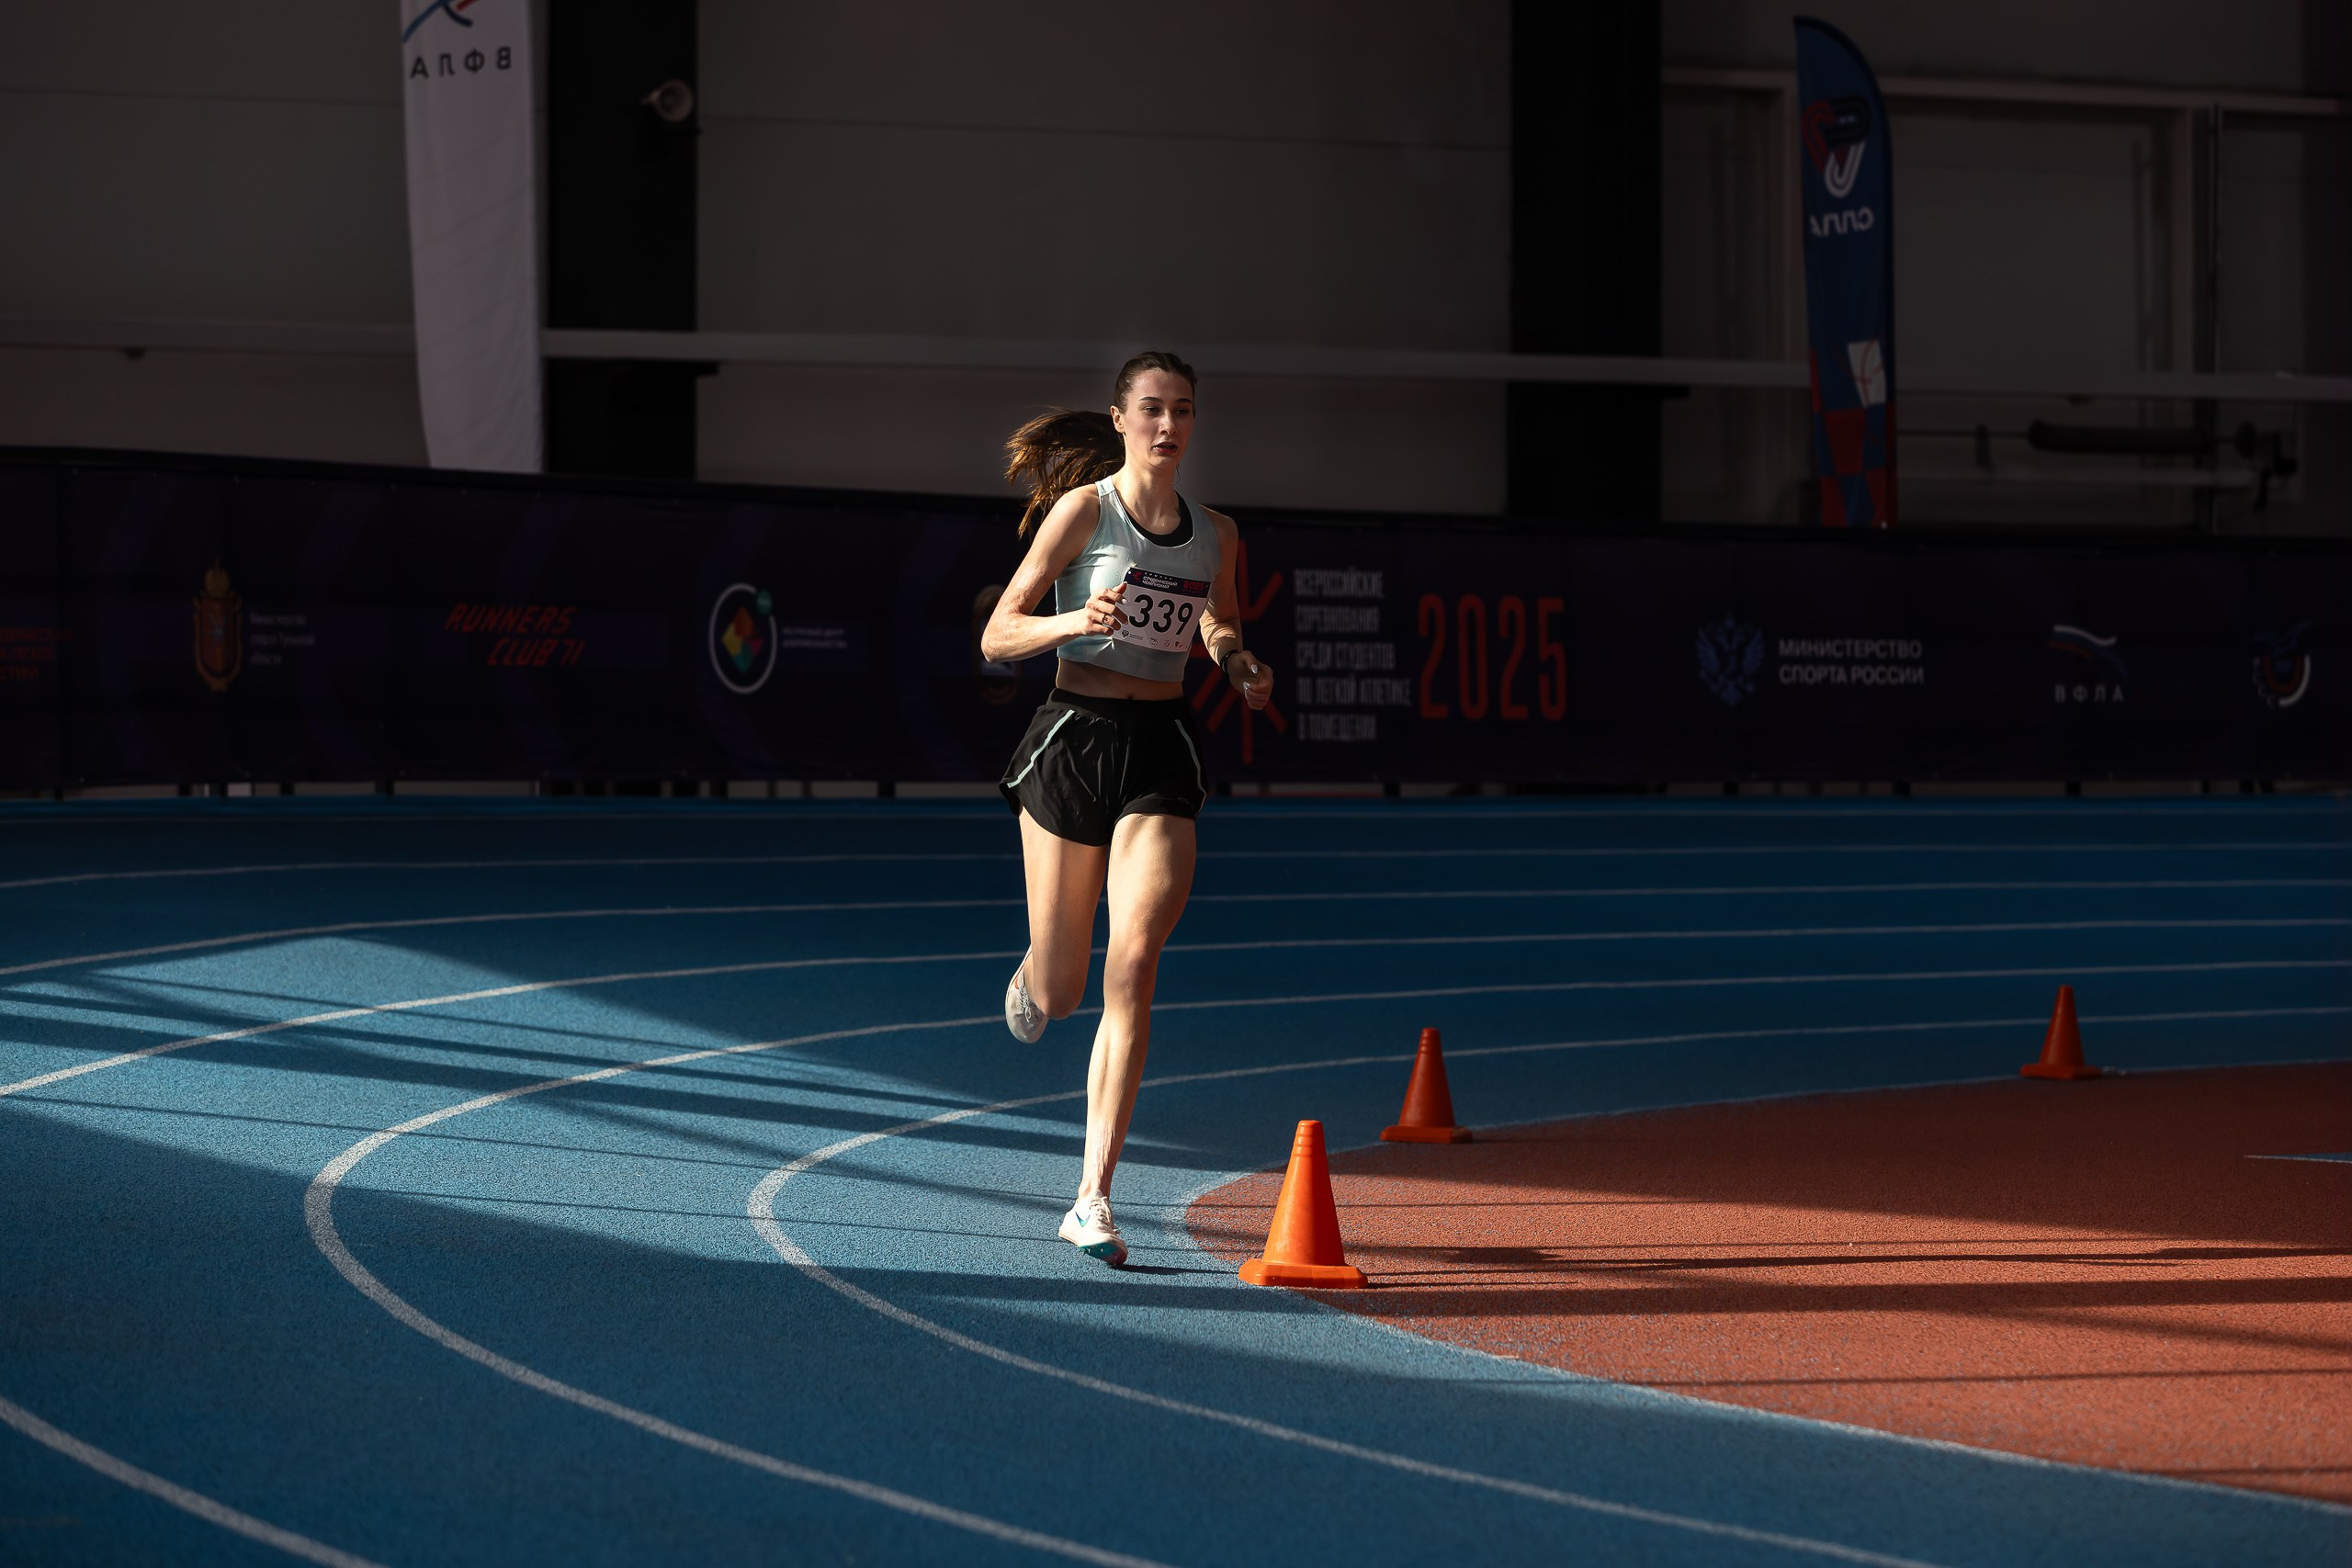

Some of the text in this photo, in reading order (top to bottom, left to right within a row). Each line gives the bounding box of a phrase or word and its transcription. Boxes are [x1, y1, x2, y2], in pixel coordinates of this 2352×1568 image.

[443, 603, 579, 634] RUNNERS
[1129, 594, 1193, 635] 339
[486, 637, 559, 667] CLUB
[1417, 592, 1568, 721] 2025
[1778, 637, 1923, 660] МИНИСТЕРСТВО
[1778, 663, 1925, 685] СПОРТА РОССИИ
[2053, 682, 2125, 705] ВФЛА
